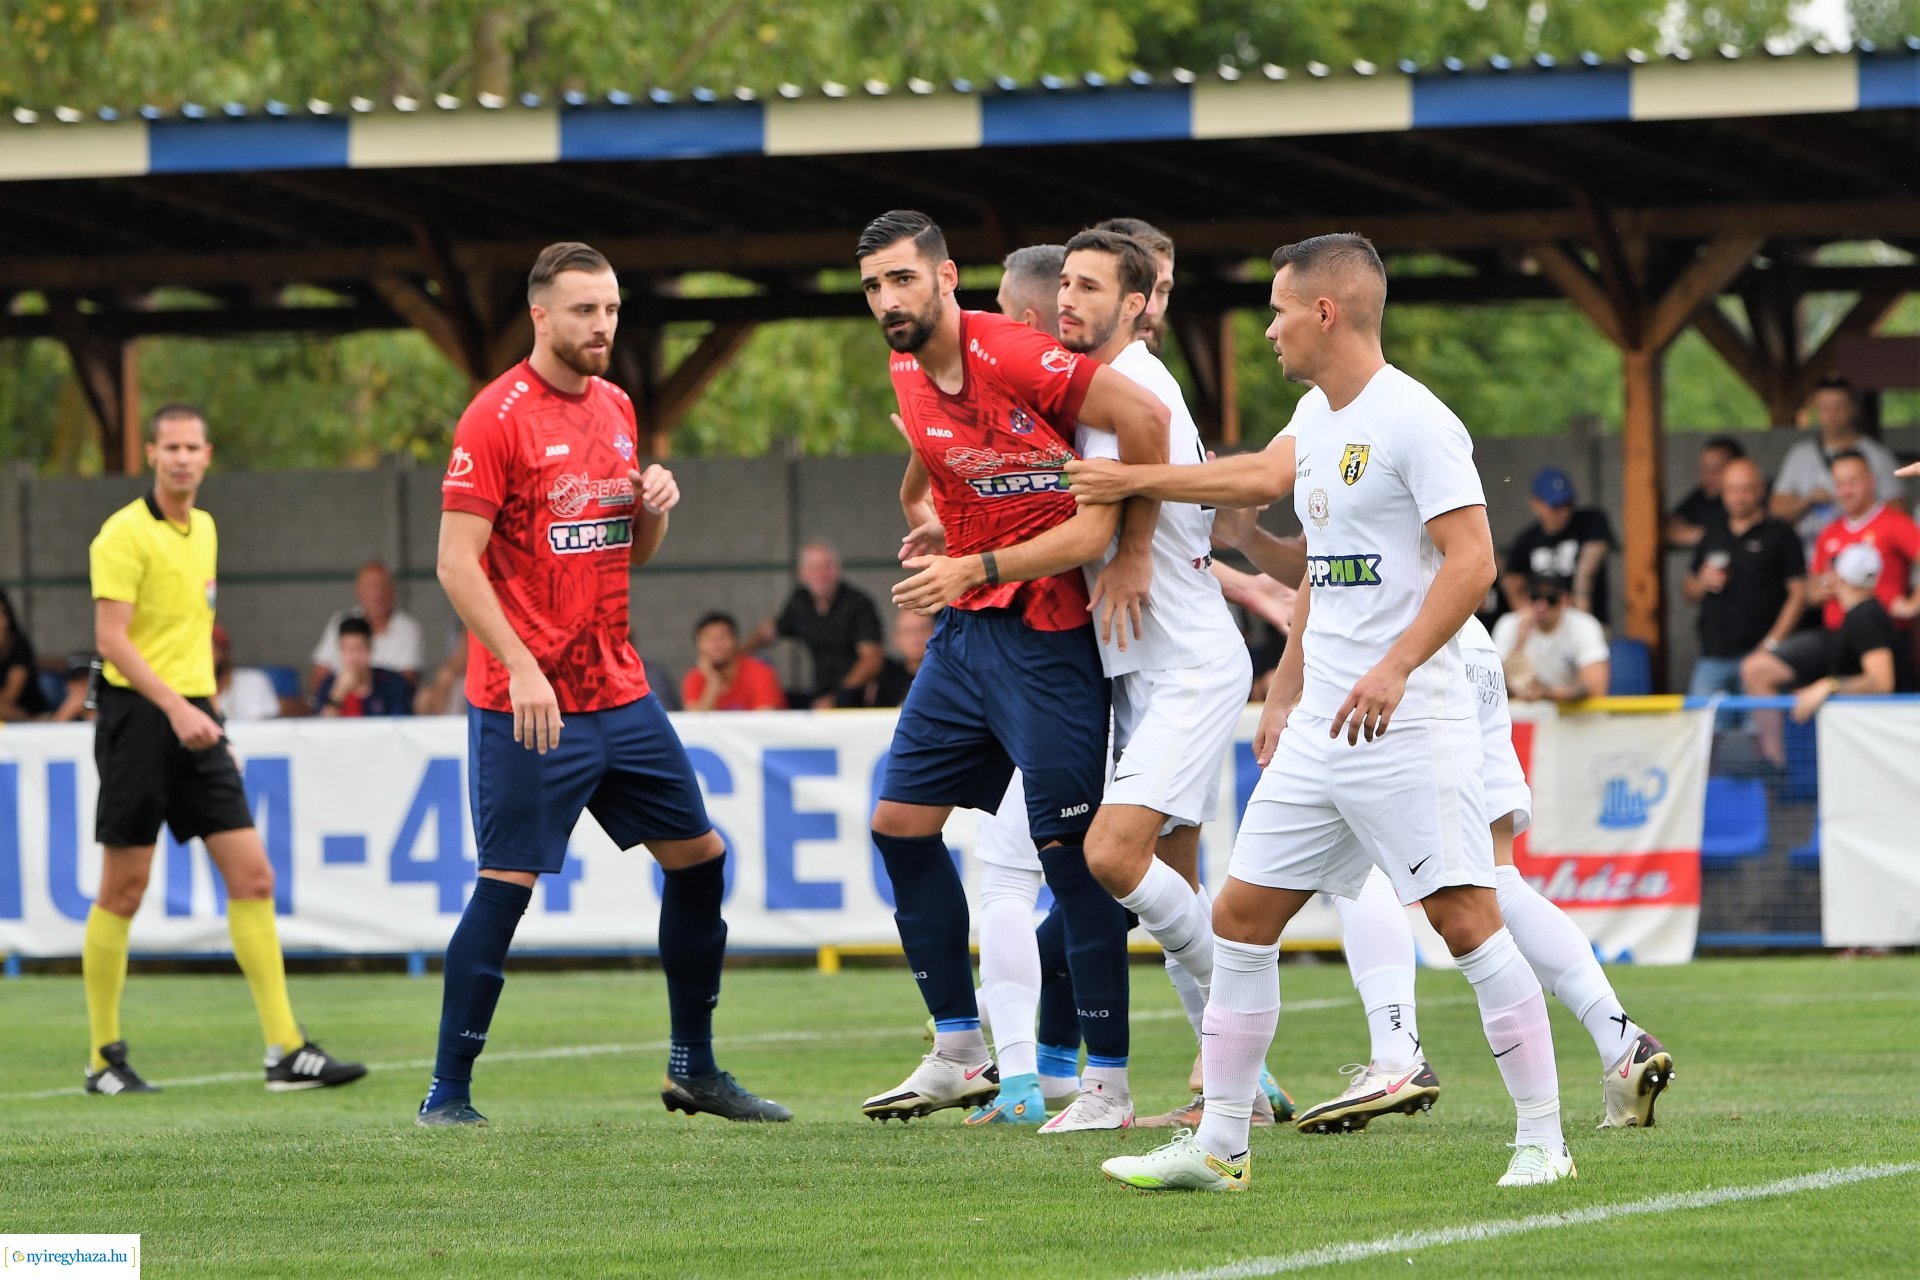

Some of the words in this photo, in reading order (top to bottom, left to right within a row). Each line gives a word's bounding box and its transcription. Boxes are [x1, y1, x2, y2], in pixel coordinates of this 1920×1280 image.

[926, 427, 954, 439] JAKO
[1306, 556, 1381, 586] PPMIX
[1060, 803, 1090, 818] JAKO
[460, 1029, 488, 1040] JAK
